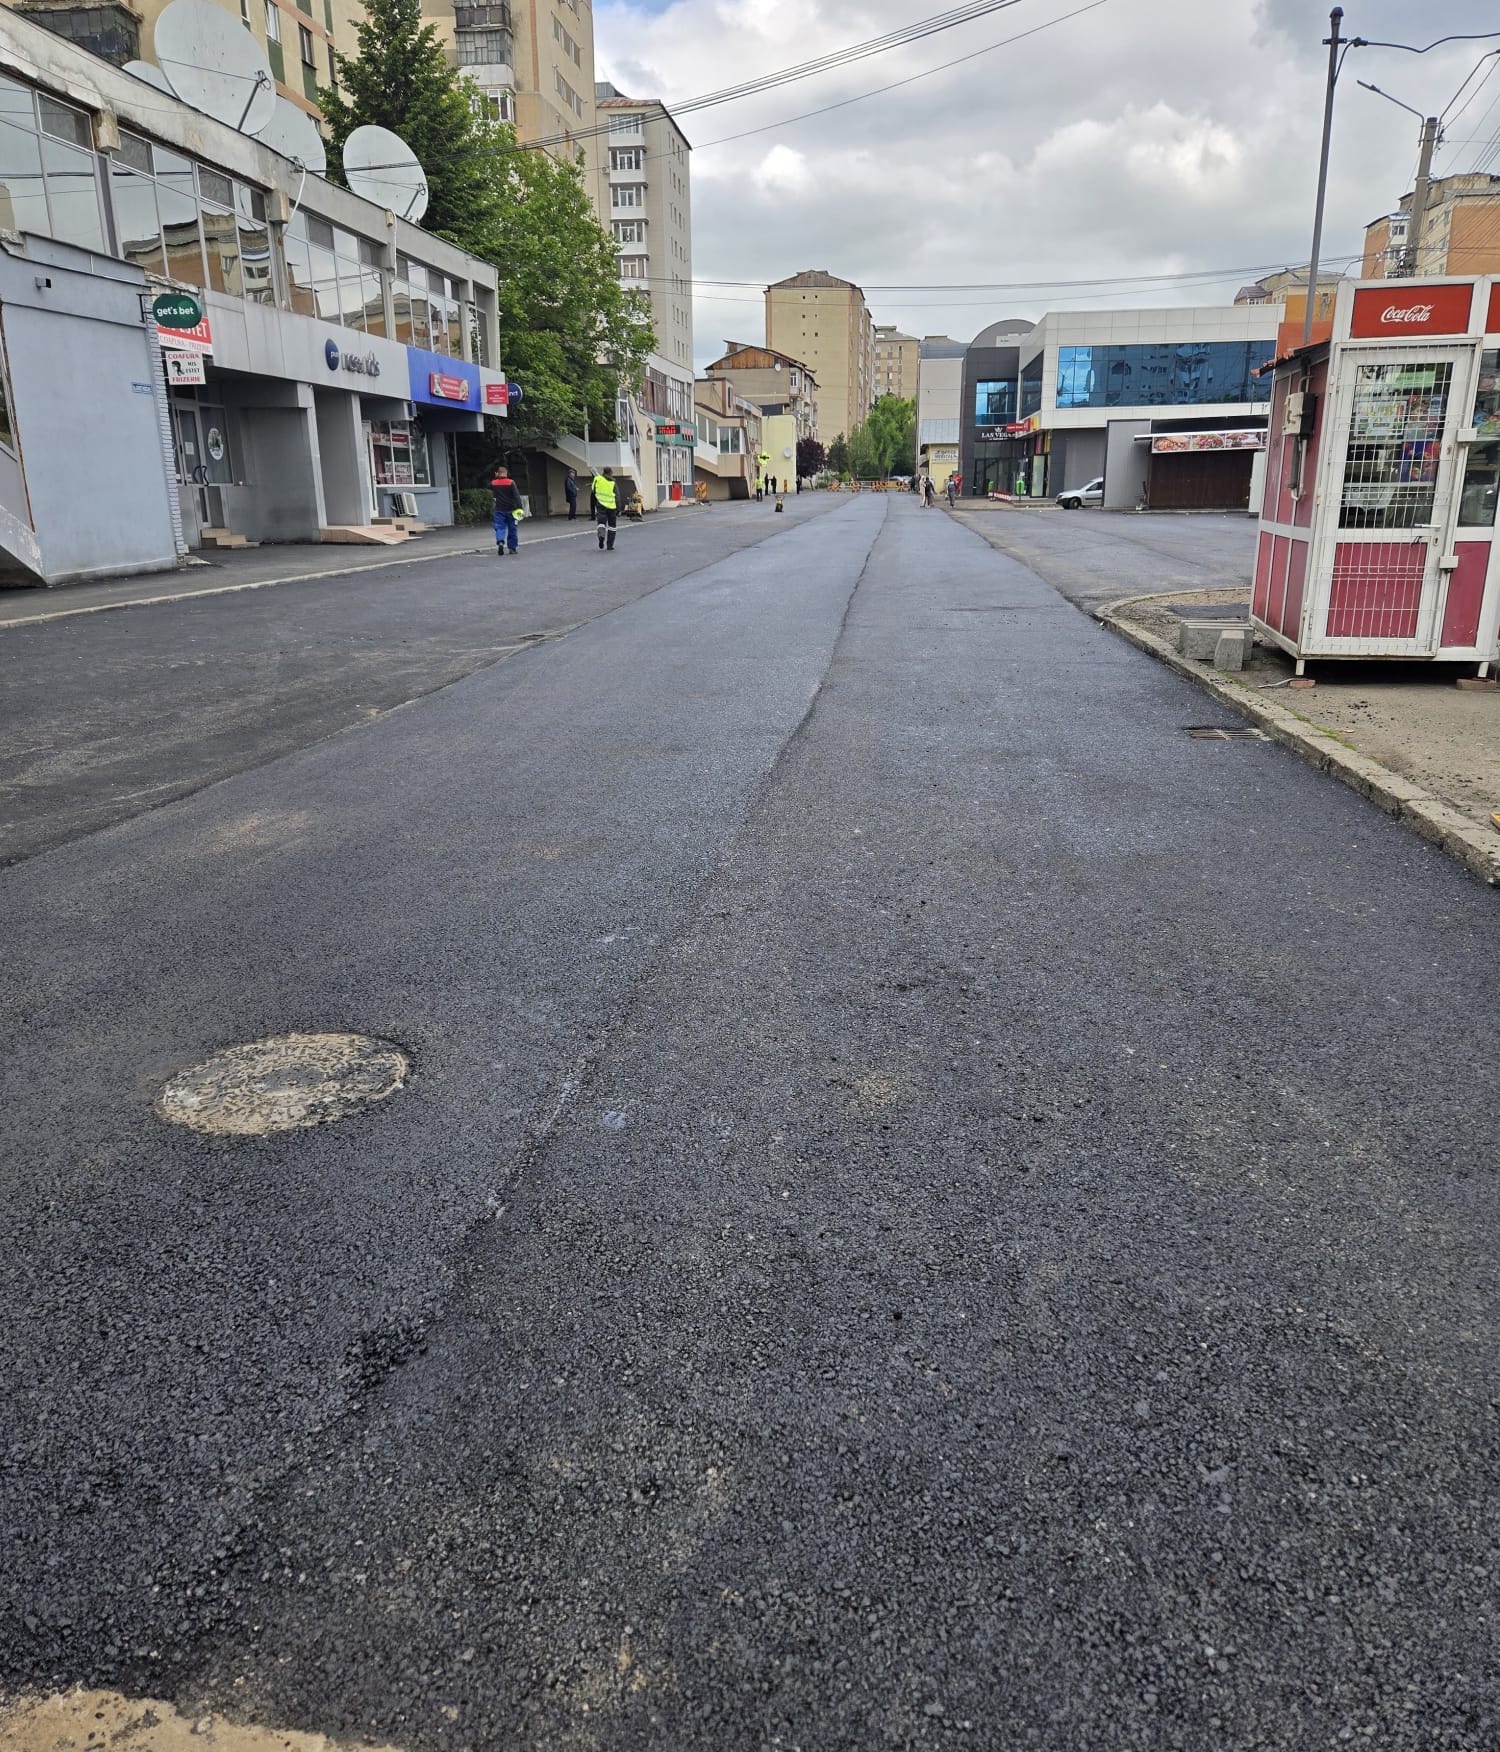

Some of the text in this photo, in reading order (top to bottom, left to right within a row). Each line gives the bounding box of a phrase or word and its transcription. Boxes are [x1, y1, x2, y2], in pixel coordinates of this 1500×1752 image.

[156, 306, 195, 317] get's bet
[1381, 304, 1435, 323] Coca-Cola
